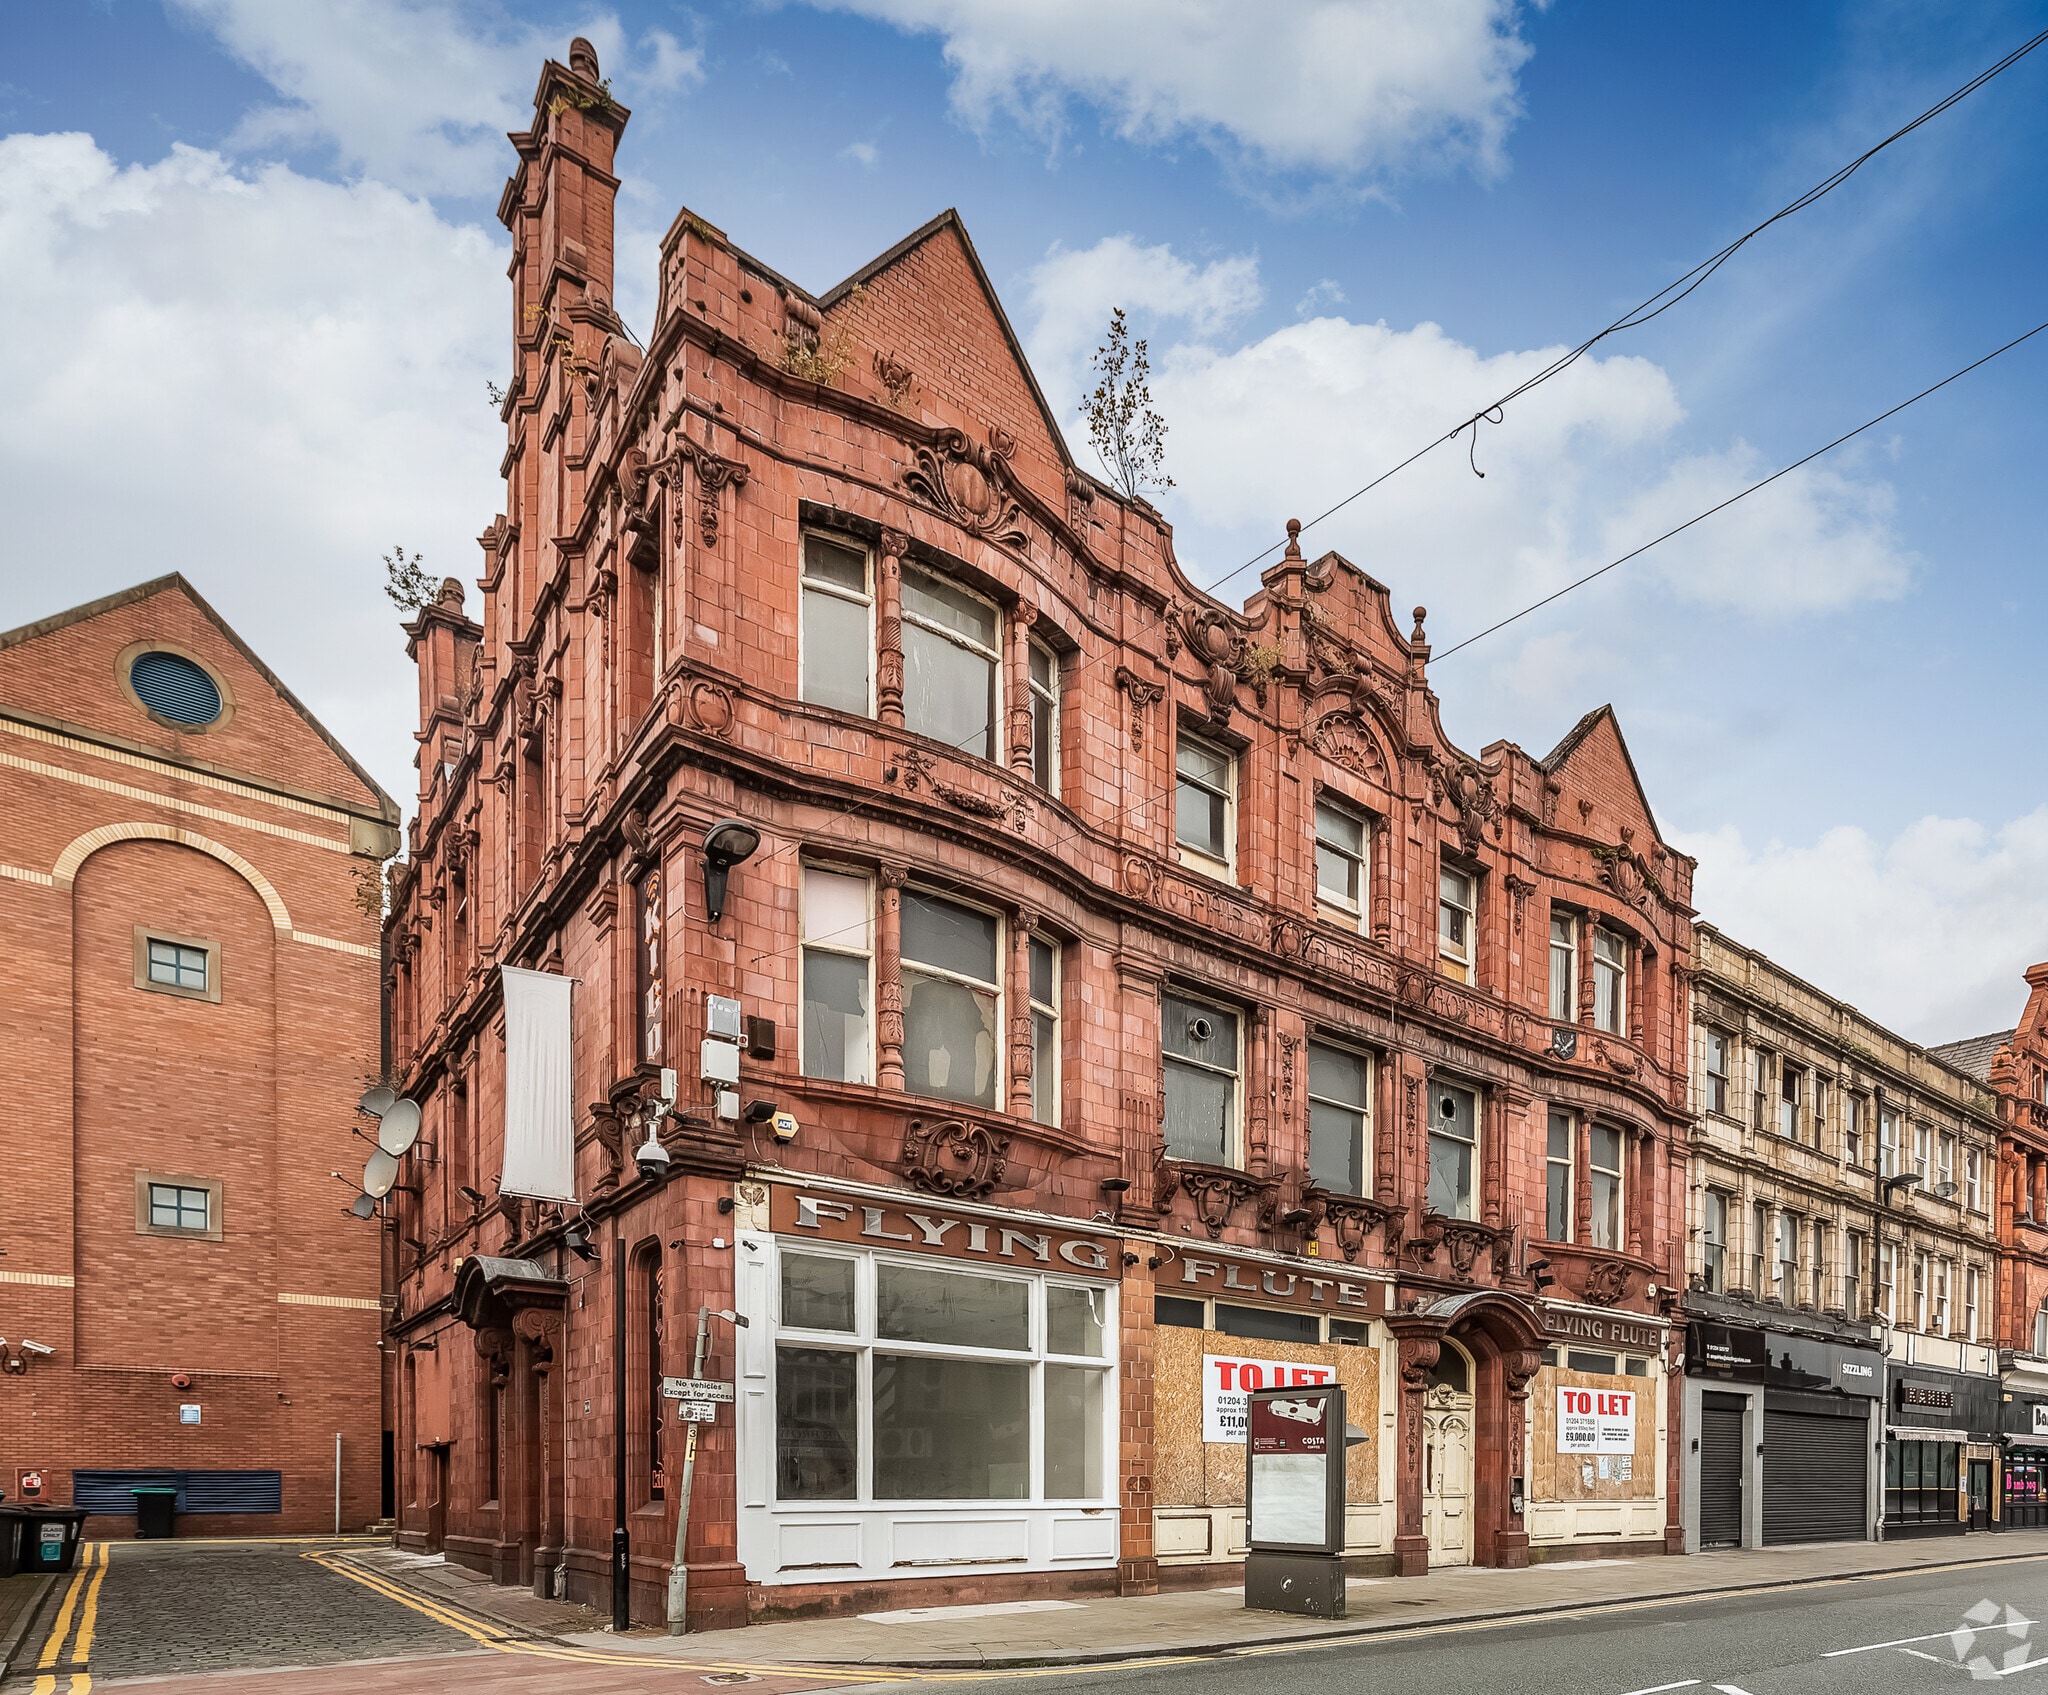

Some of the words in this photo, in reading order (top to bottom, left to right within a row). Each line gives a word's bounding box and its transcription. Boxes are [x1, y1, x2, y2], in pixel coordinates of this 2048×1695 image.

[778, 1119, 792, 1130] ADT
[794, 1195, 1109, 1271] FLYING
[1181, 1257, 1368, 1307] FLUTE
[1544, 1313, 1603, 1339] FLYING
[1610, 1323, 1658, 1347] FLUTE
[1842, 1363, 1873, 1377] SIZZLING
[1214, 1361, 1263, 1393] TO
[690, 1382, 722, 1390] vehicles
[664, 1388, 691, 1397] Except
[1218, 1396, 1241, 1405] 01204
[1563, 1391, 1591, 1415] TO
[1597, 1393, 1631, 1416] LET
[689, 1429, 696, 1438] 3
[1566, 1432, 1595, 1442] £9,000.00
[1302, 1436, 1325, 1445] COSTA
